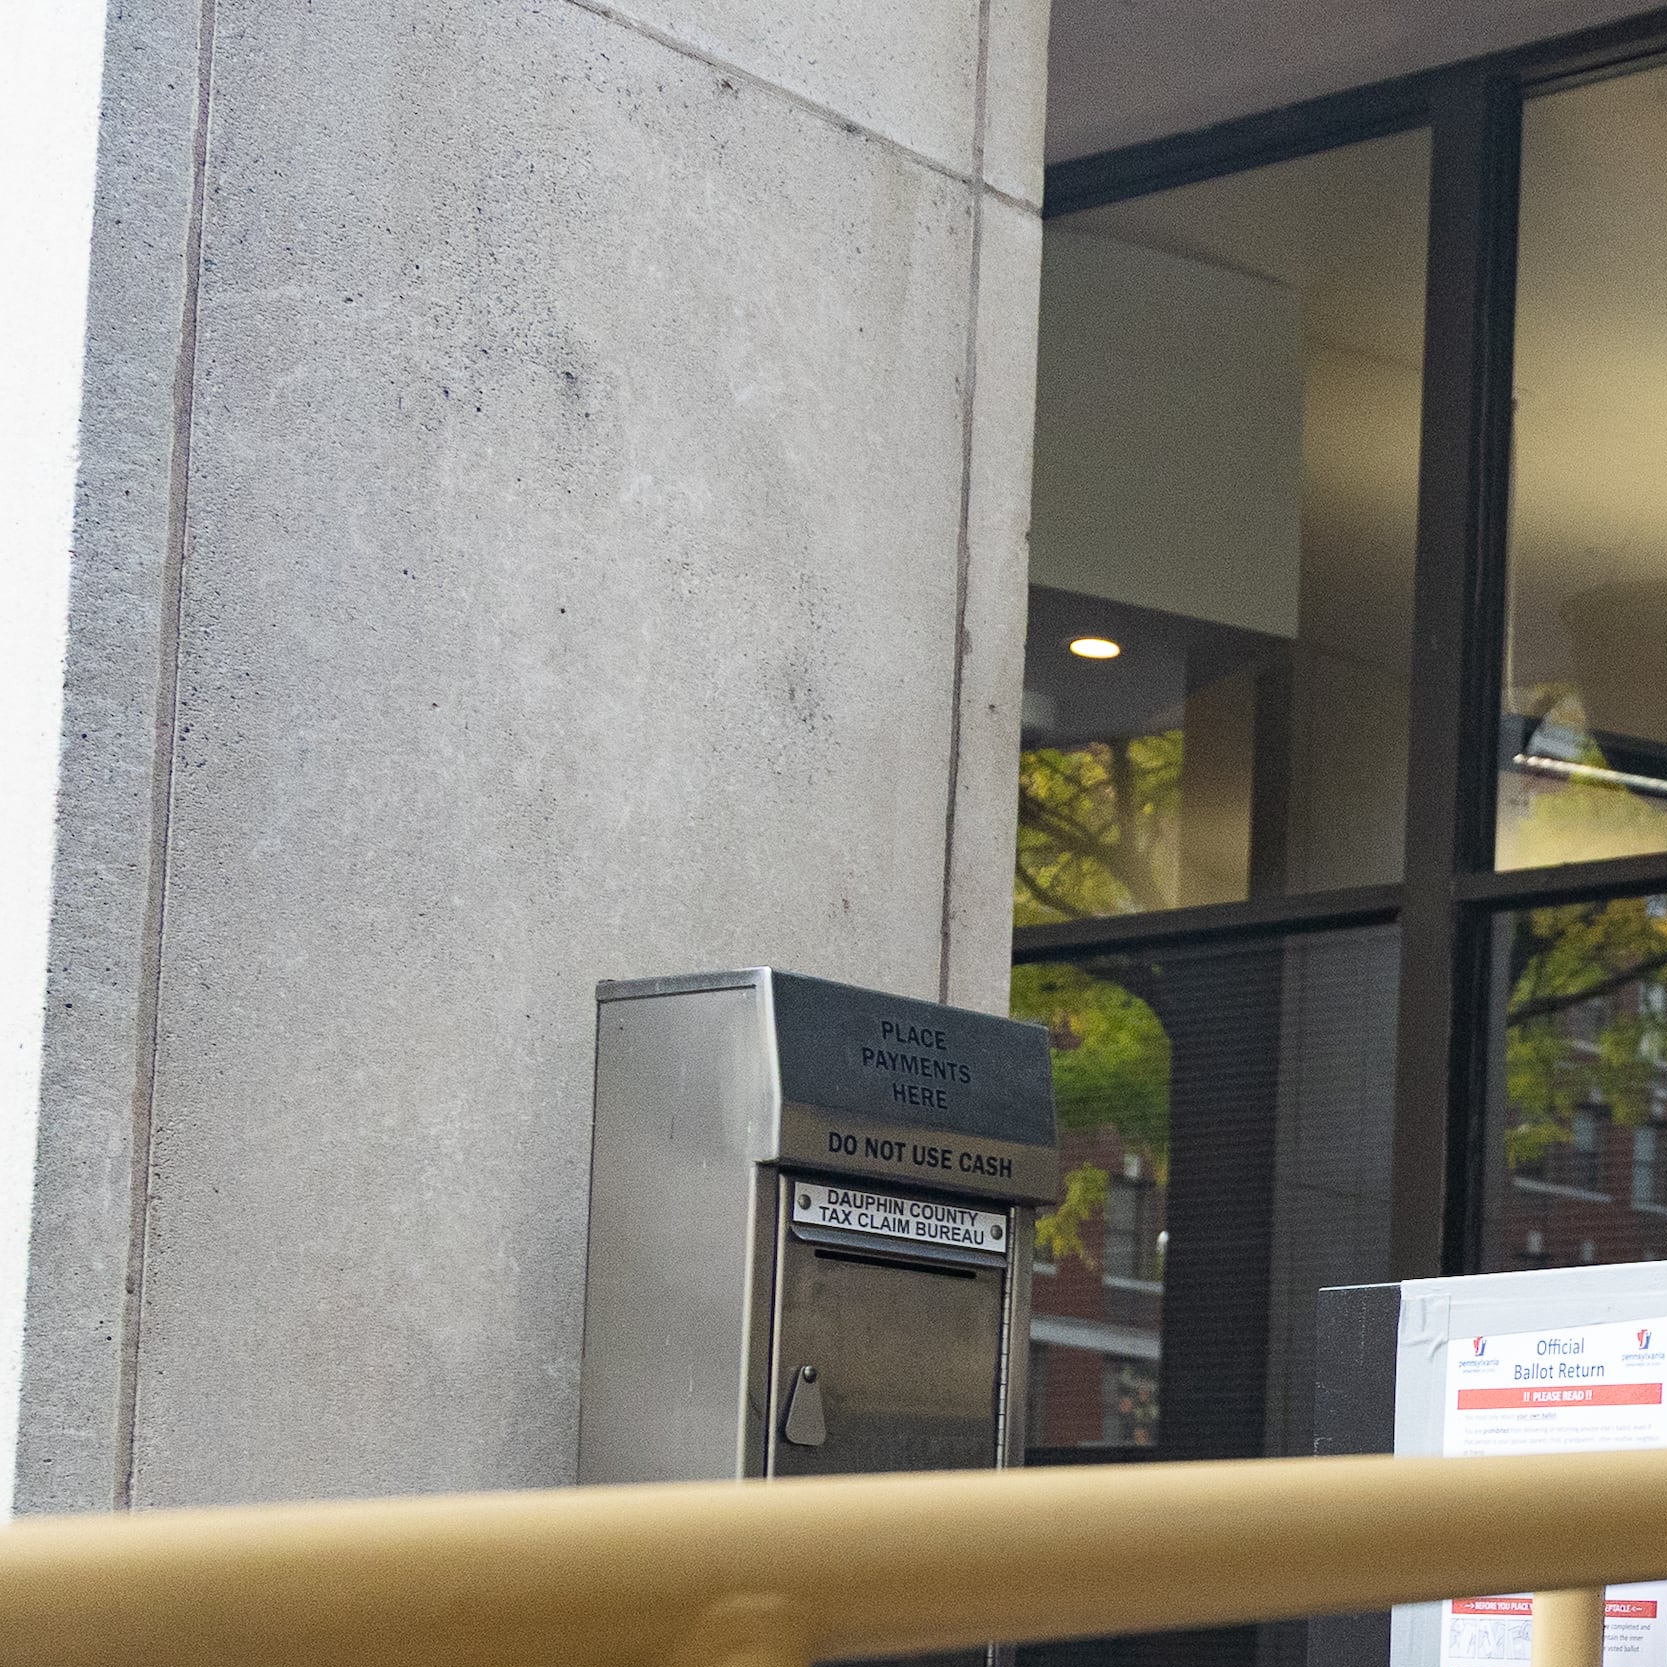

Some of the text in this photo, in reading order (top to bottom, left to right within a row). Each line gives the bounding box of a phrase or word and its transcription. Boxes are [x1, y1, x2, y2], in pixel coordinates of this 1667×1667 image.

[882, 1021, 947, 1050] PLACE
[862, 1047, 971, 1084] PAYMENTS
[892, 1082, 948, 1110] HERE
[828, 1131, 1013, 1178] DO NOT USE CASH
[827, 1189, 978, 1227] DAUPHIN COUNTY
[819, 1206, 984, 1245] TAX CLAIM BUREAU
[1537, 1337, 1584, 1356] Official
[1514, 1362, 1605, 1380] Ballot Return
[1523, 1389, 1593, 1402] !! PLEASE READ !!
[1475, 1602, 1497, 1610] BEFORE
[1497, 1602, 1510, 1610] YOU
[1511, 1602, 1530, 1611] PLACE
